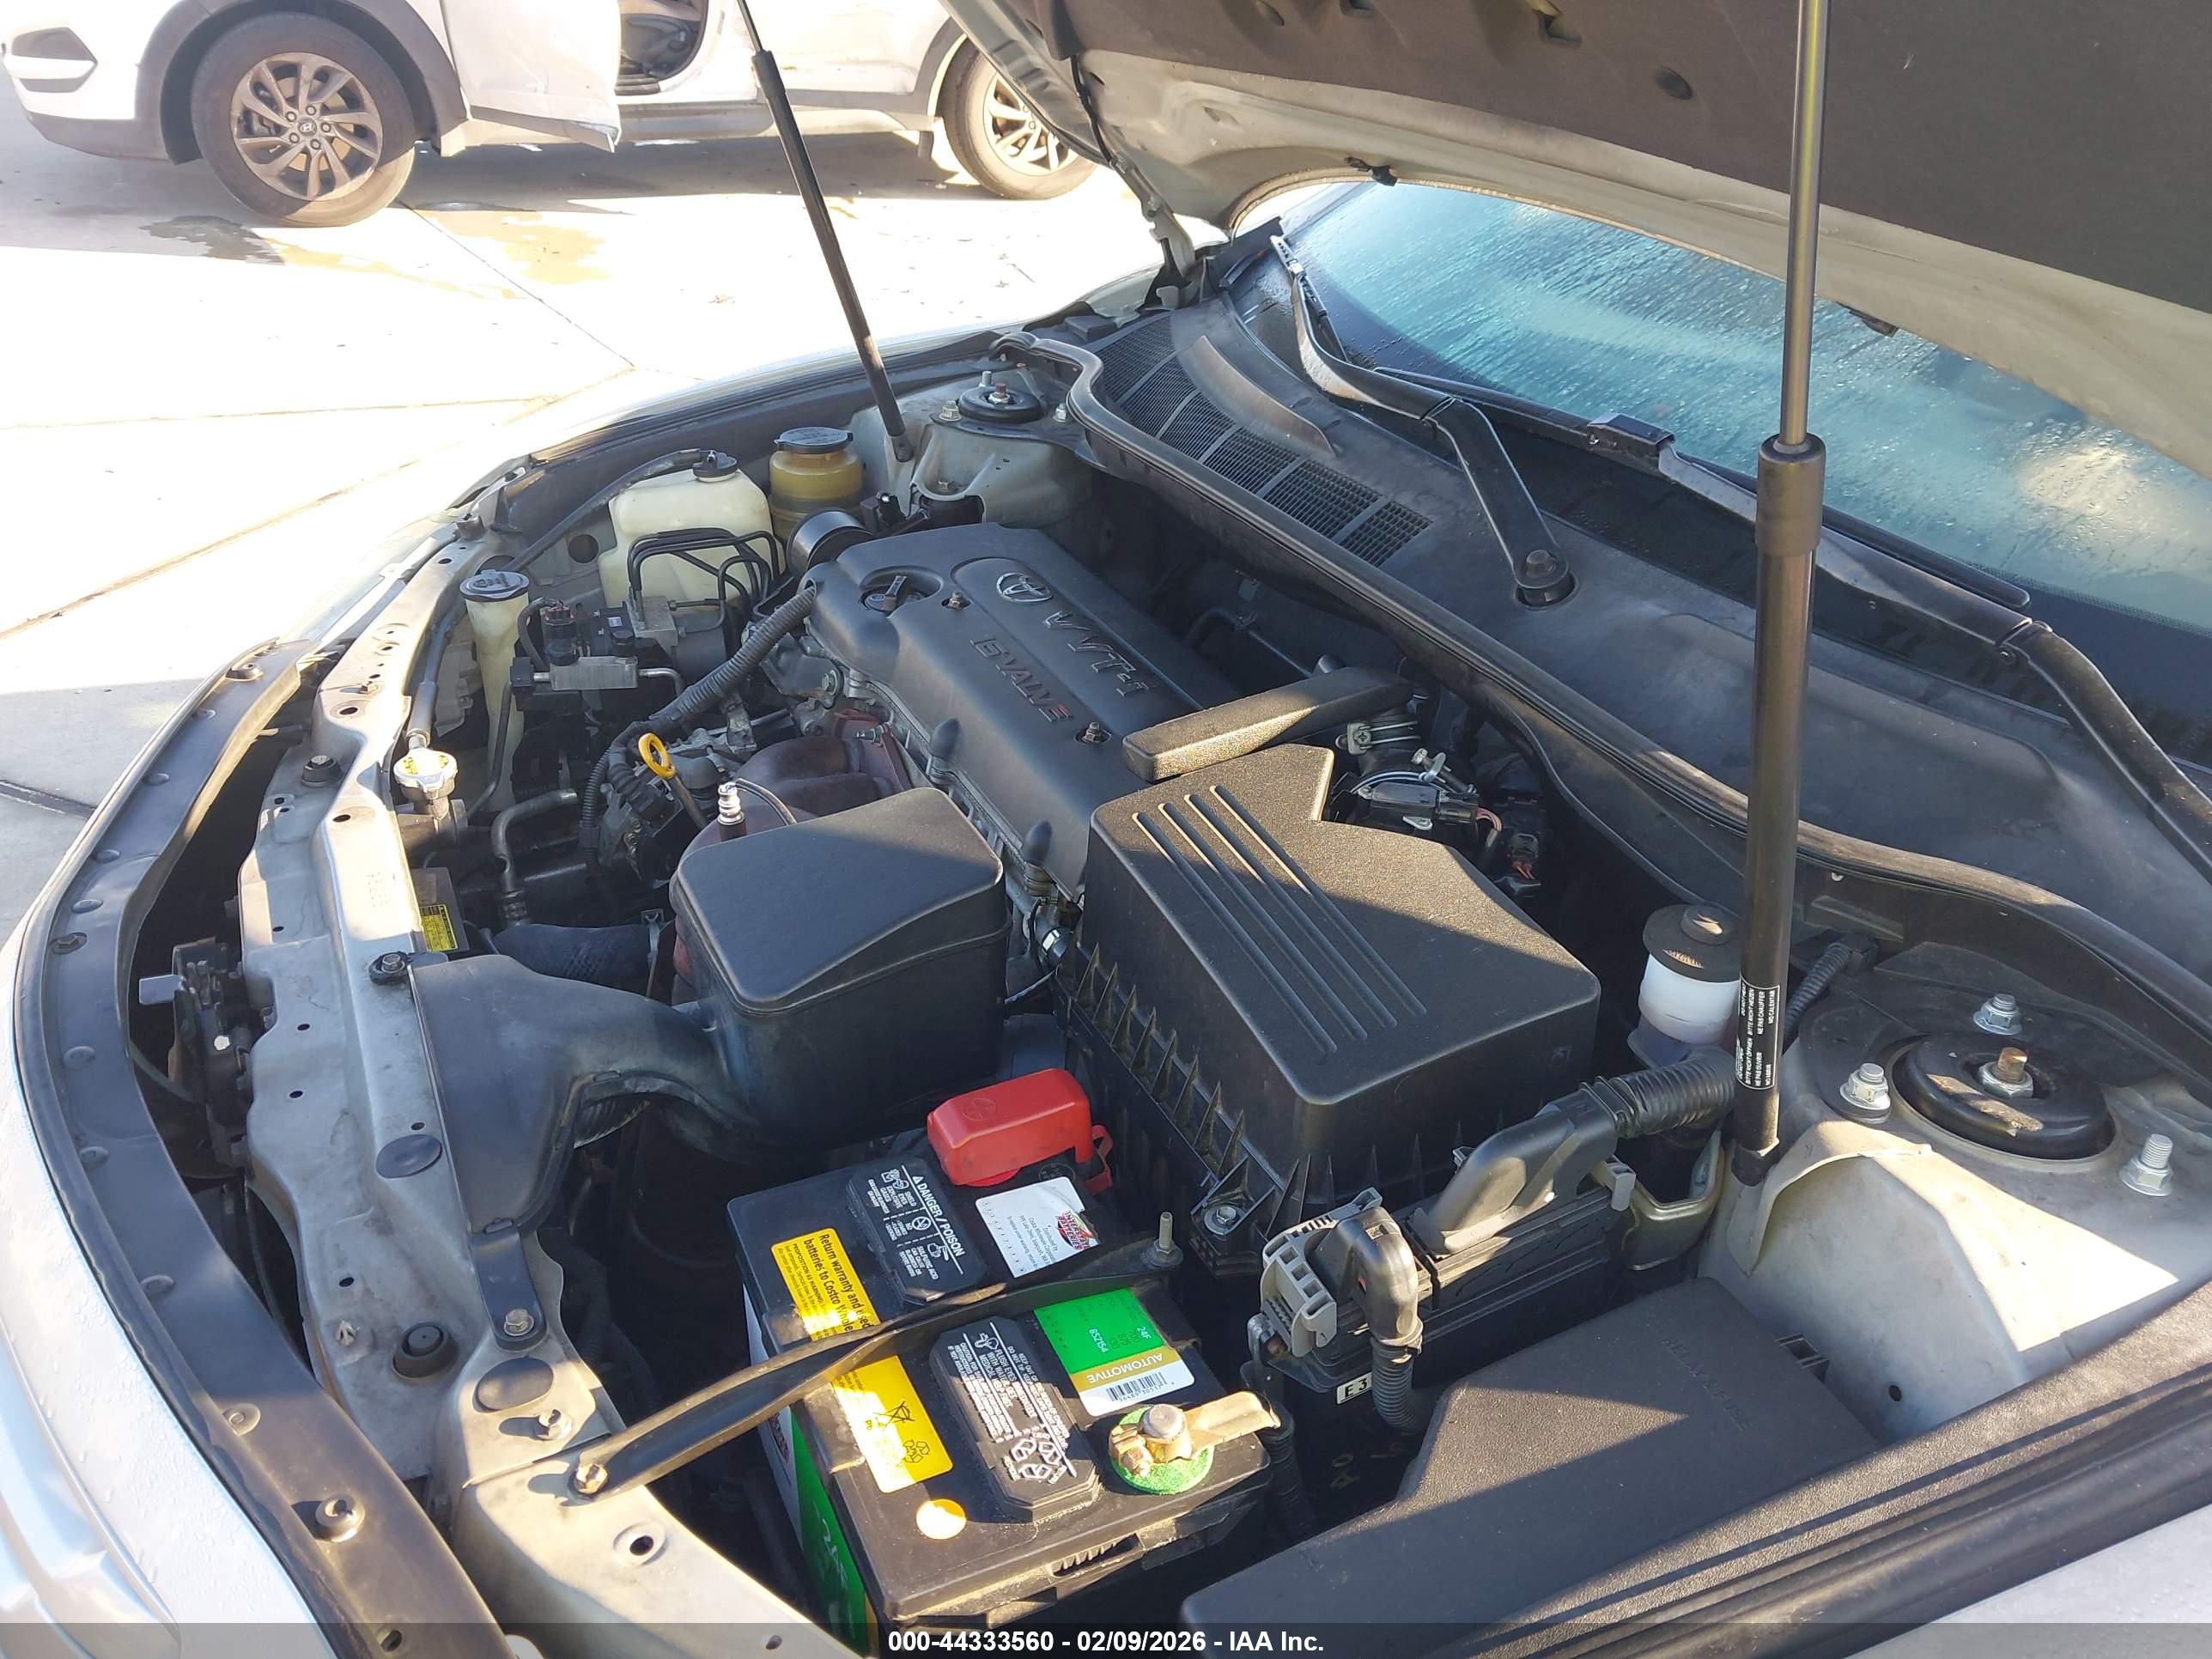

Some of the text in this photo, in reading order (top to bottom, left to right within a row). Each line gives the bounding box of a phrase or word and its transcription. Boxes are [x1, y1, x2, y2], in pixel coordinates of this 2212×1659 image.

[916, 1182, 943, 1217] DANGER
[939, 1222, 965, 1256] POISON
[1057, 1214, 1082, 1250] BATTERIES
[802, 1237, 828, 1271] batteries
[817, 1233, 839, 1260] Return
[817, 1271, 830, 1280] to
[826, 1257, 854, 1294] warranty
[822, 1279, 843, 1304] Costco
[847, 1291, 865, 1309] and
[1087, 1328, 1110, 1352] 652154
[1136, 1326, 1152, 1340] 24F
[978, 1353, 997, 1377] MEDICAL
[986, 1351, 1000, 1366] WITH
[993, 1347, 1009, 1367] FLUSH
[1004, 1366, 1018, 1382] EYES
[1085, 1352, 1166, 1383] AUTOMOTIVE
